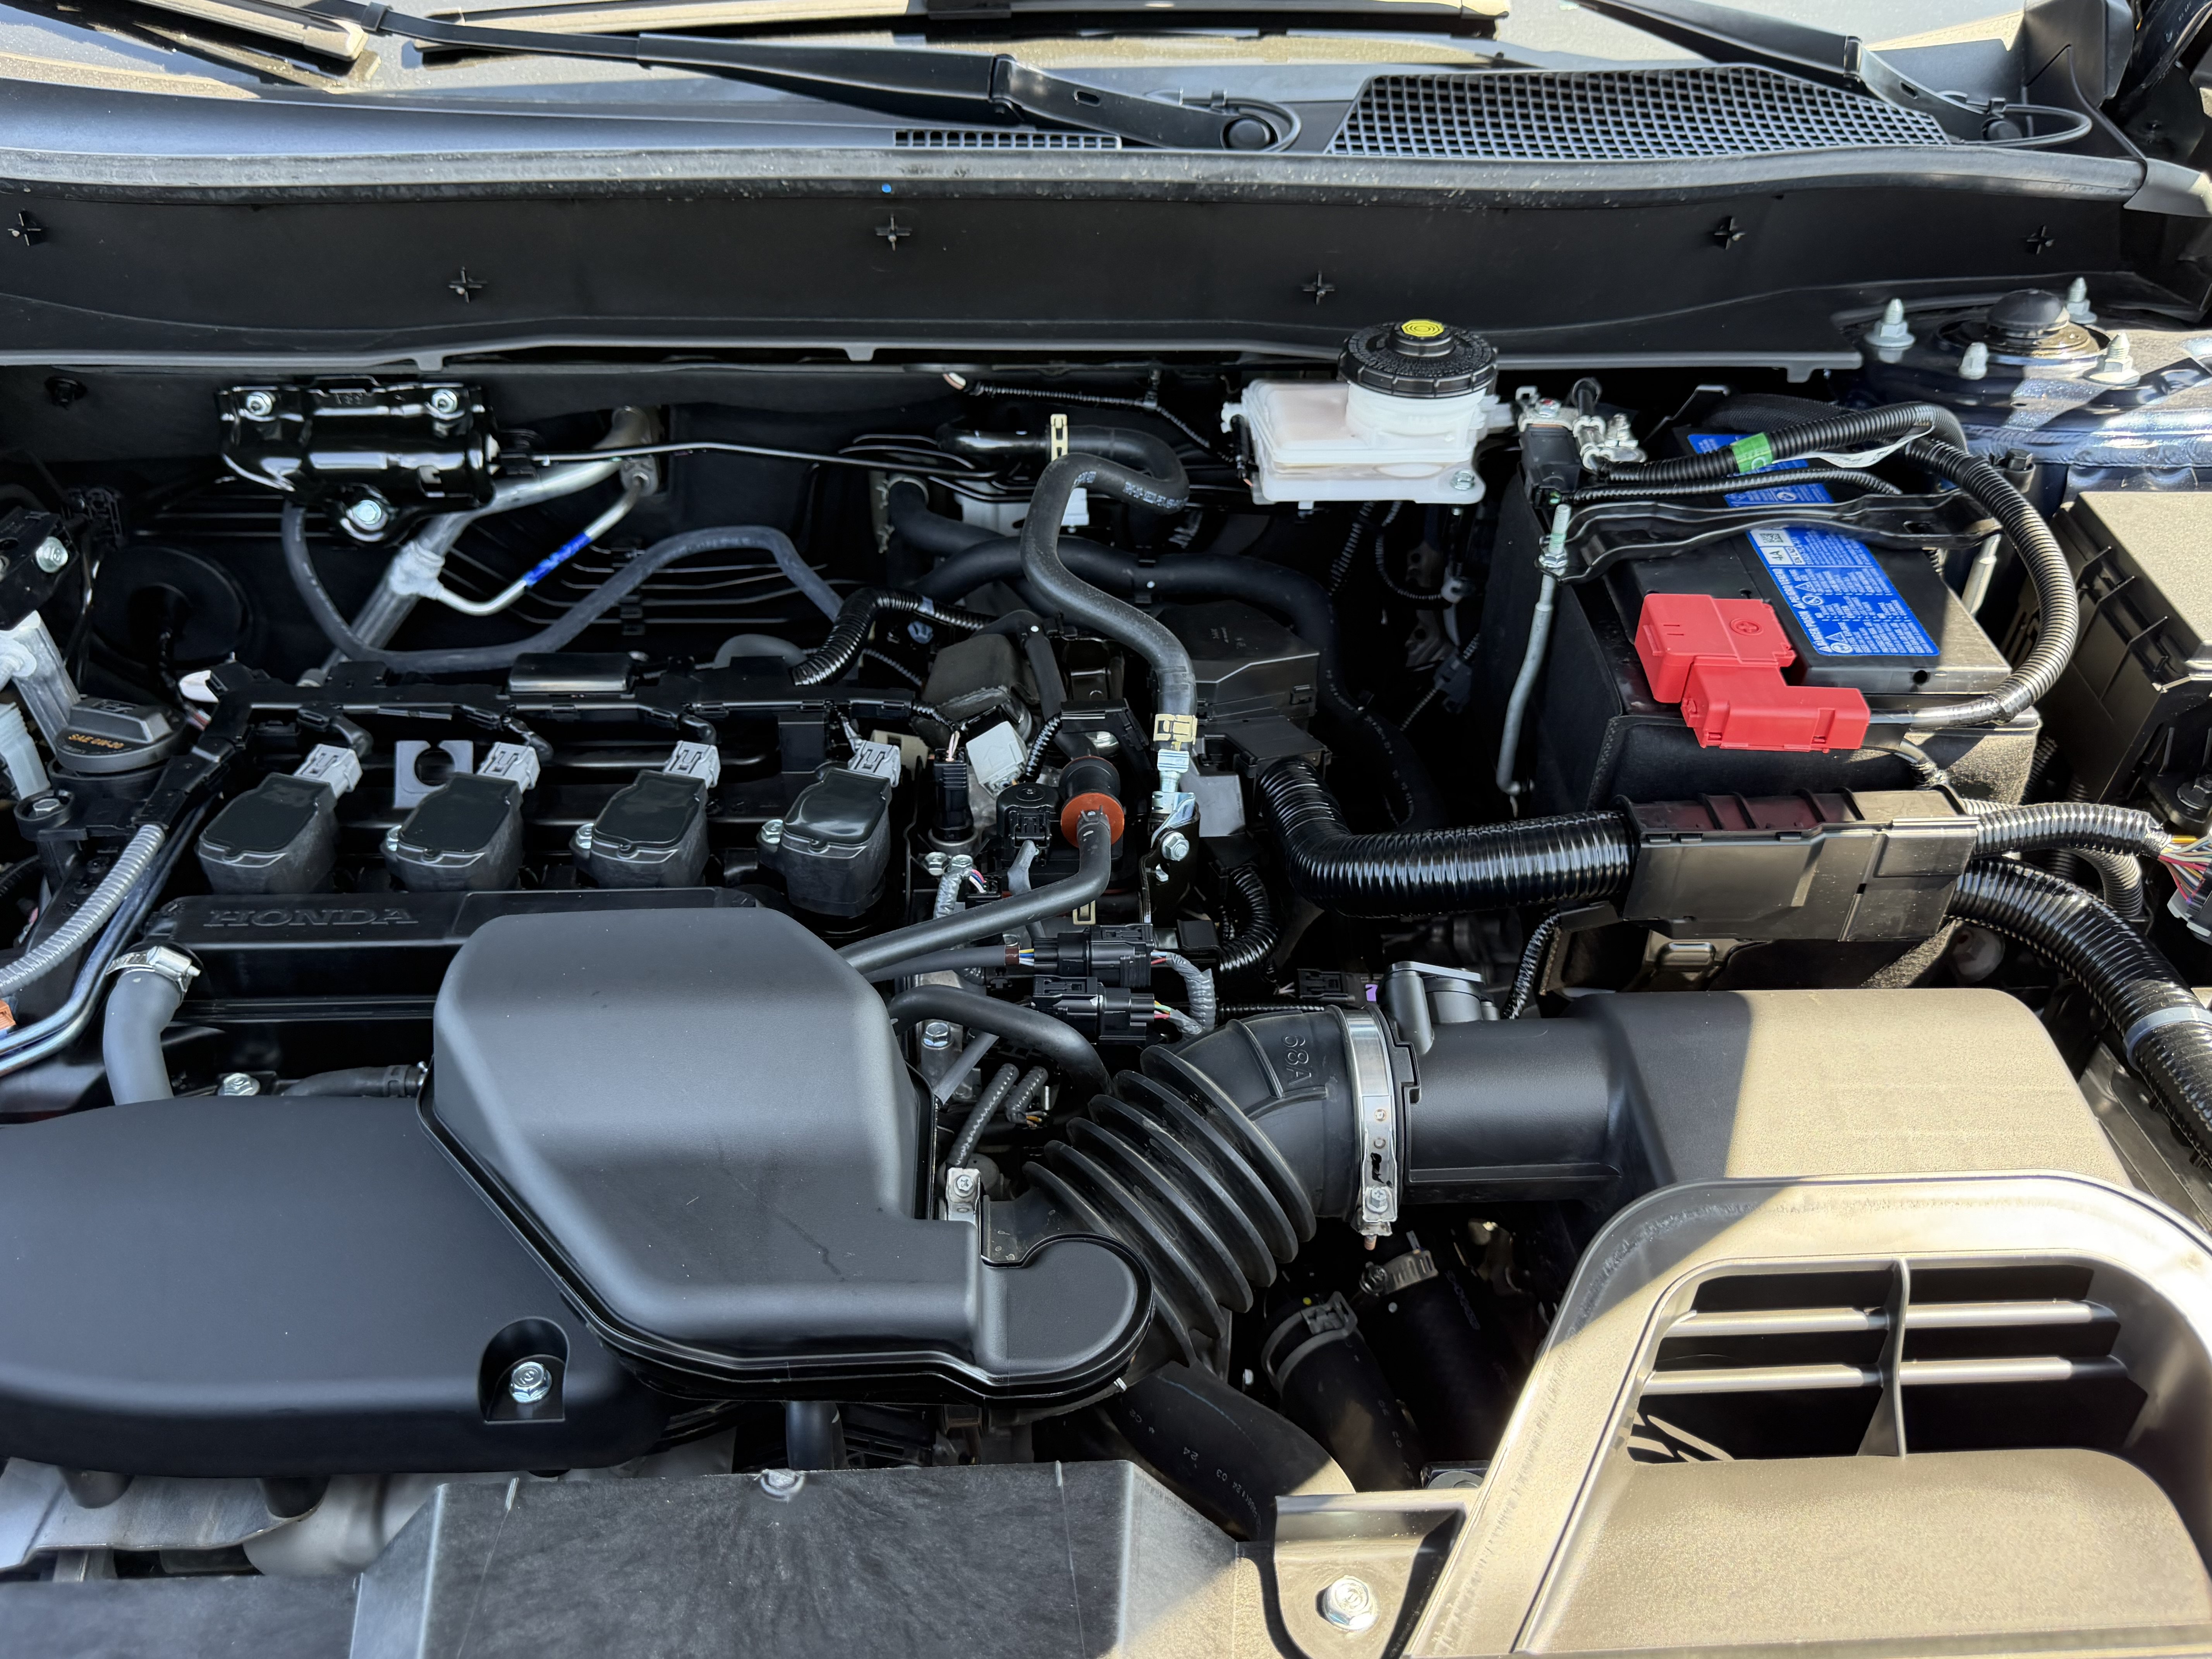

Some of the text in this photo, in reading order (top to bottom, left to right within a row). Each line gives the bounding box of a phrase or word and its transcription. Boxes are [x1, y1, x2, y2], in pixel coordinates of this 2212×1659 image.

[1769, 551, 1784, 560] 4A
[68, 733, 94, 743] SAE
[203, 907, 419, 927] HONDA
[1283, 1035, 1312, 1086] 68A
